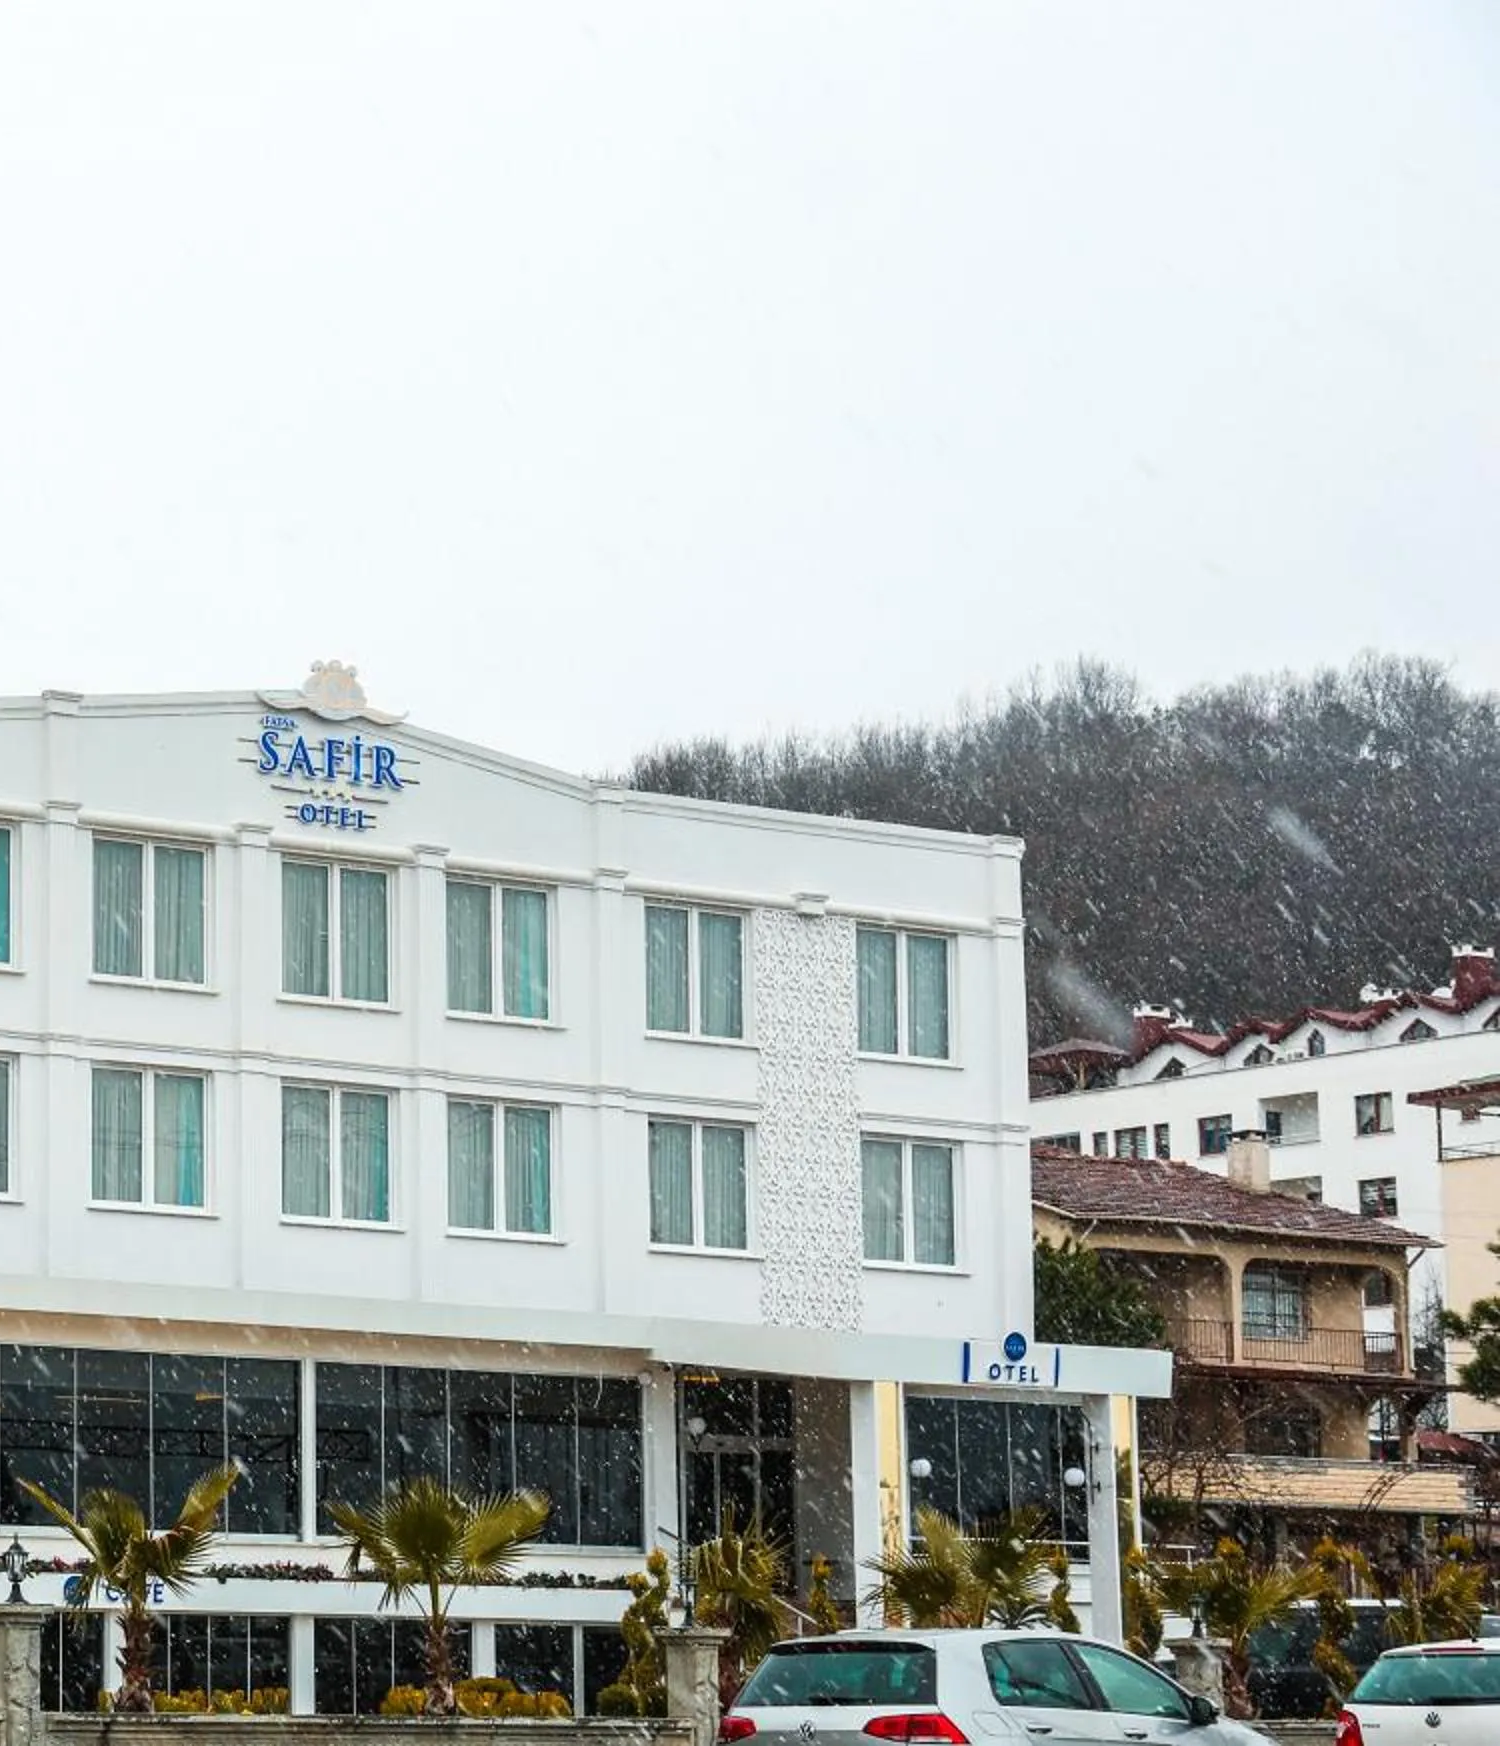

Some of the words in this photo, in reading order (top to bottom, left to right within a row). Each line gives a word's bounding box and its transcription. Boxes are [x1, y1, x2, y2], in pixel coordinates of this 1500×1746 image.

[258, 731, 404, 789] SAFİR
[299, 803, 366, 831] OTEL
[989, 1363, 1040, 1382] OTEL
